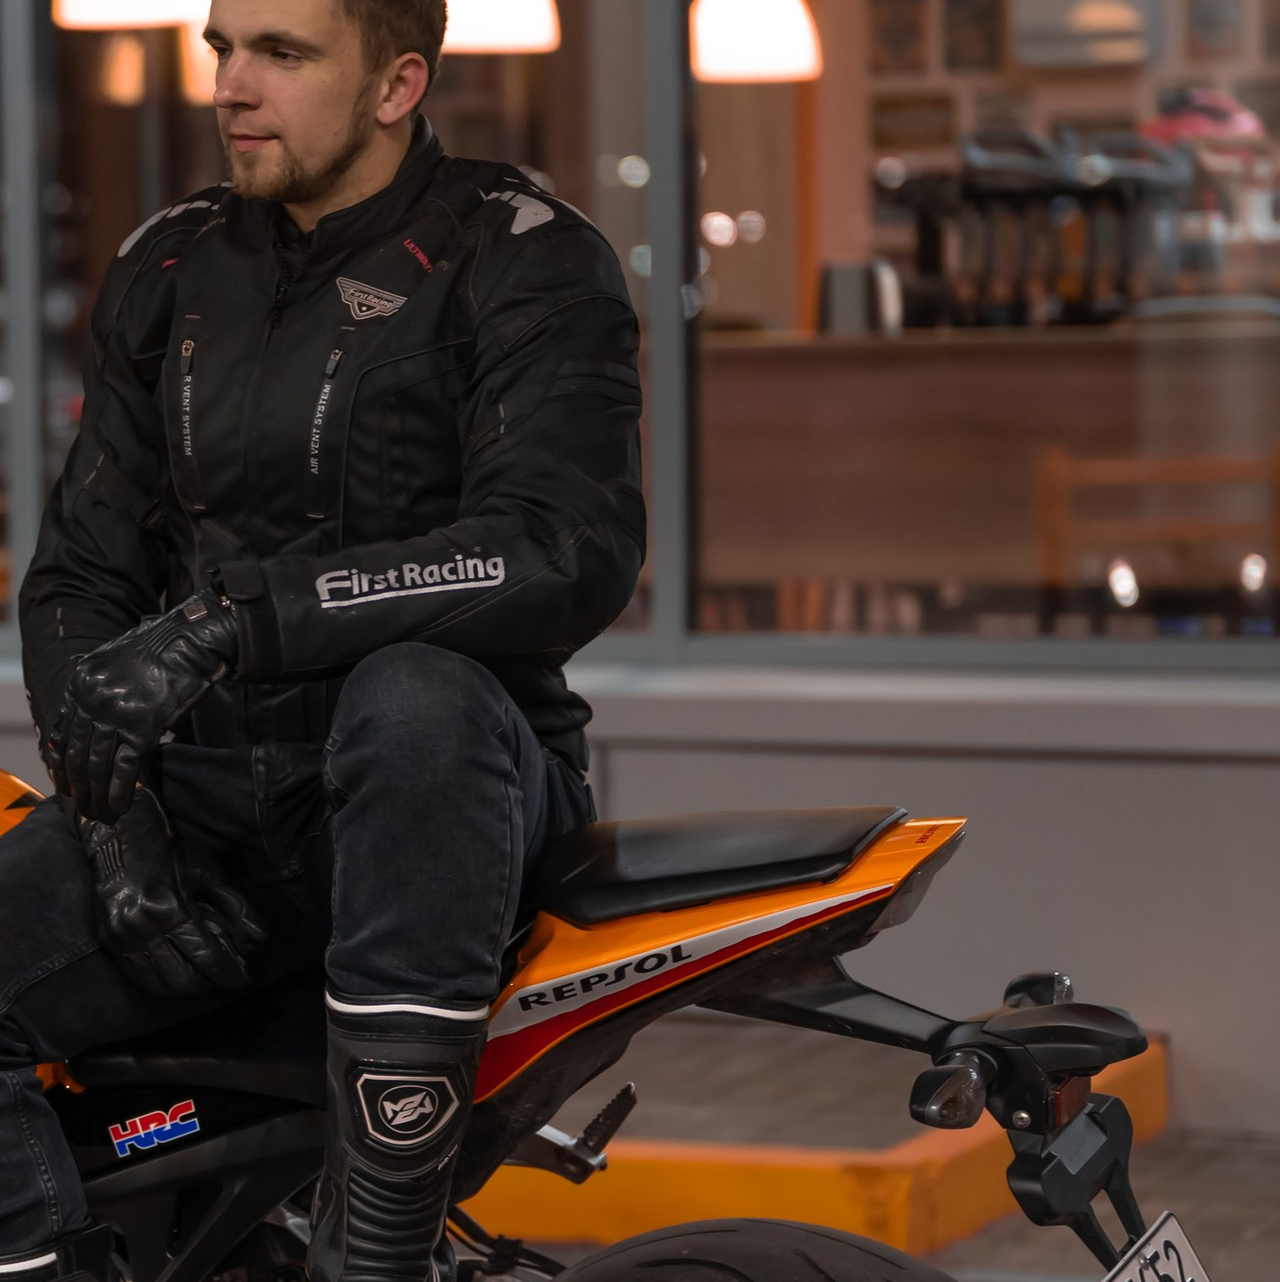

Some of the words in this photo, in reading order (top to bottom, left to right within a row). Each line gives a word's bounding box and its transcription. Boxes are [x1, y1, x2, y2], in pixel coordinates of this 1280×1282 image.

[182, 385, 191, 412] VENT
[314, 384, 332, 425] SYSTEM
[182, 414, 193, 456] SYSTEM
[311, 428, 321, 456] VENT
[310, 457, 319, 475] AIR
[517, 944, 693, 1012] REPSOL
[108, 1099, 201, 1158] HRC
